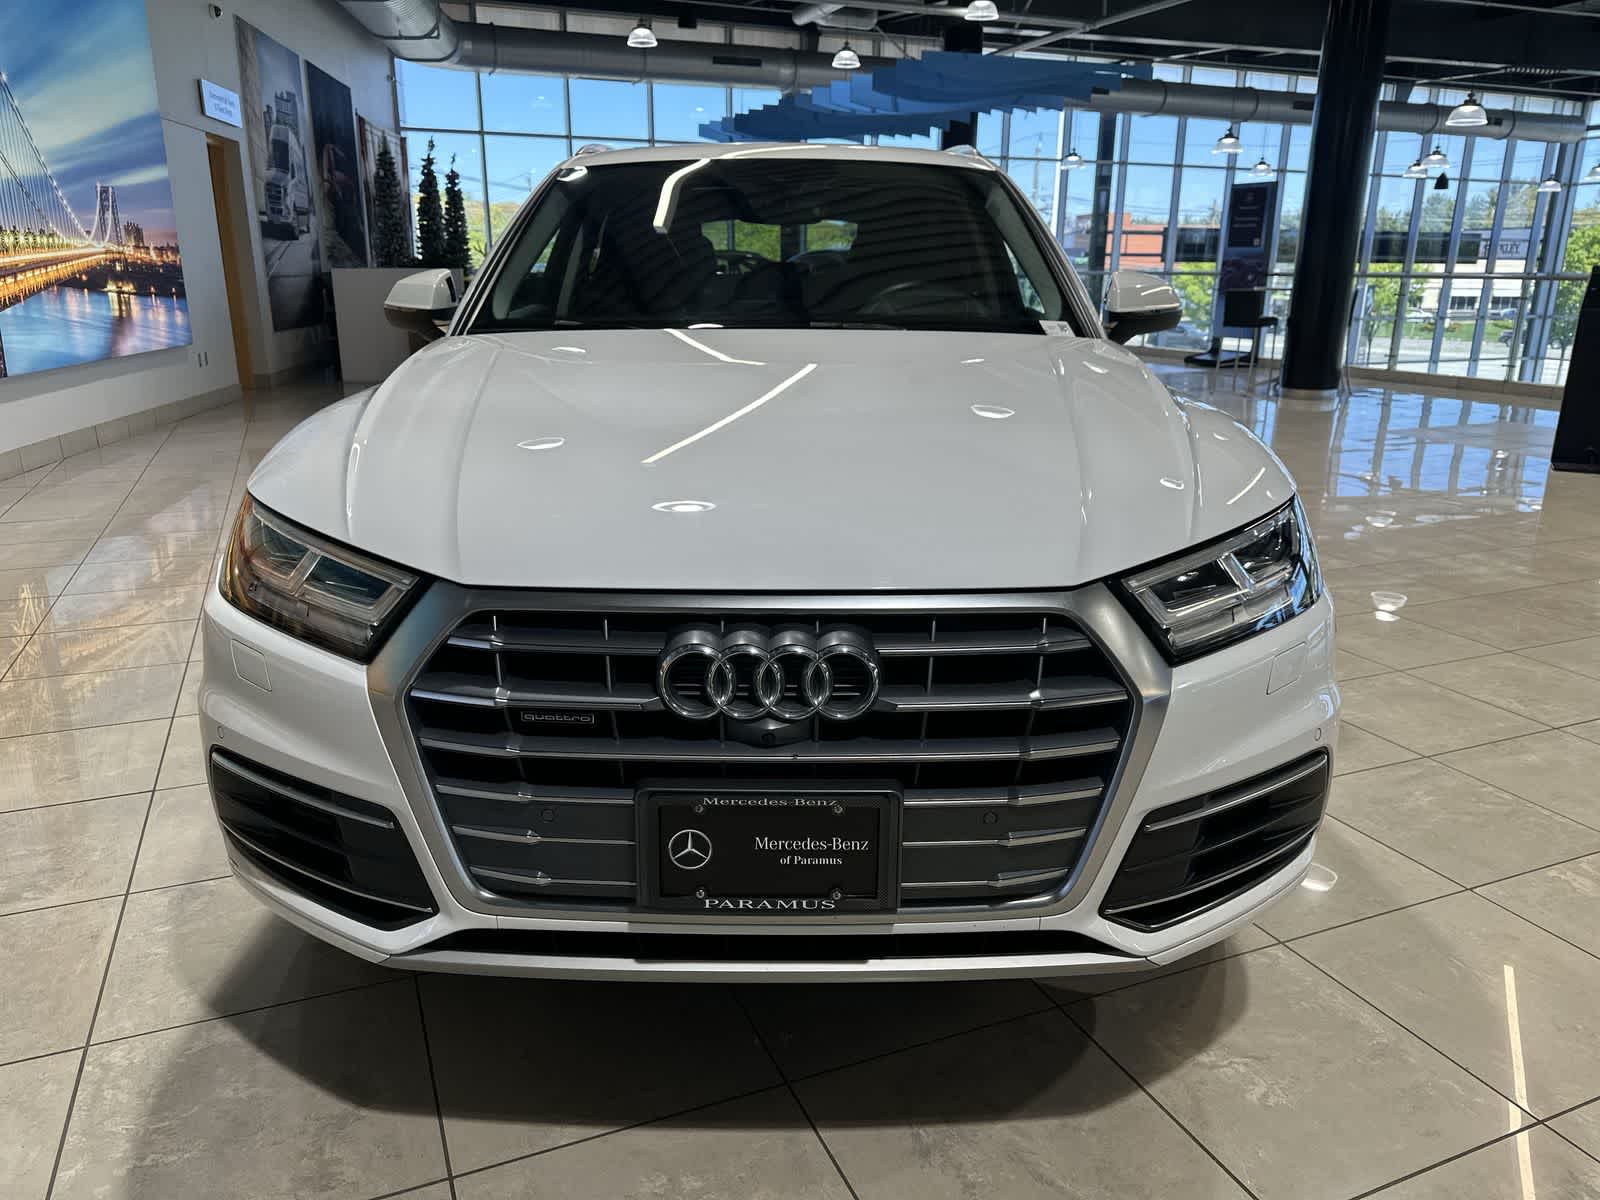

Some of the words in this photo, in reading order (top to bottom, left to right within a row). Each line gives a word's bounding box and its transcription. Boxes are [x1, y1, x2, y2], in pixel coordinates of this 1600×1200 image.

[523, 713, 592, 722] quattro
[702, 797, 837, 807] Mercedes-Benz
[754, 836, 869, 851] Mercedes-Benz
[780, 855, 791, 865] of
[794, 855, 843, 866] Paramus
[703, 899, 836, 910] PARAMUS
